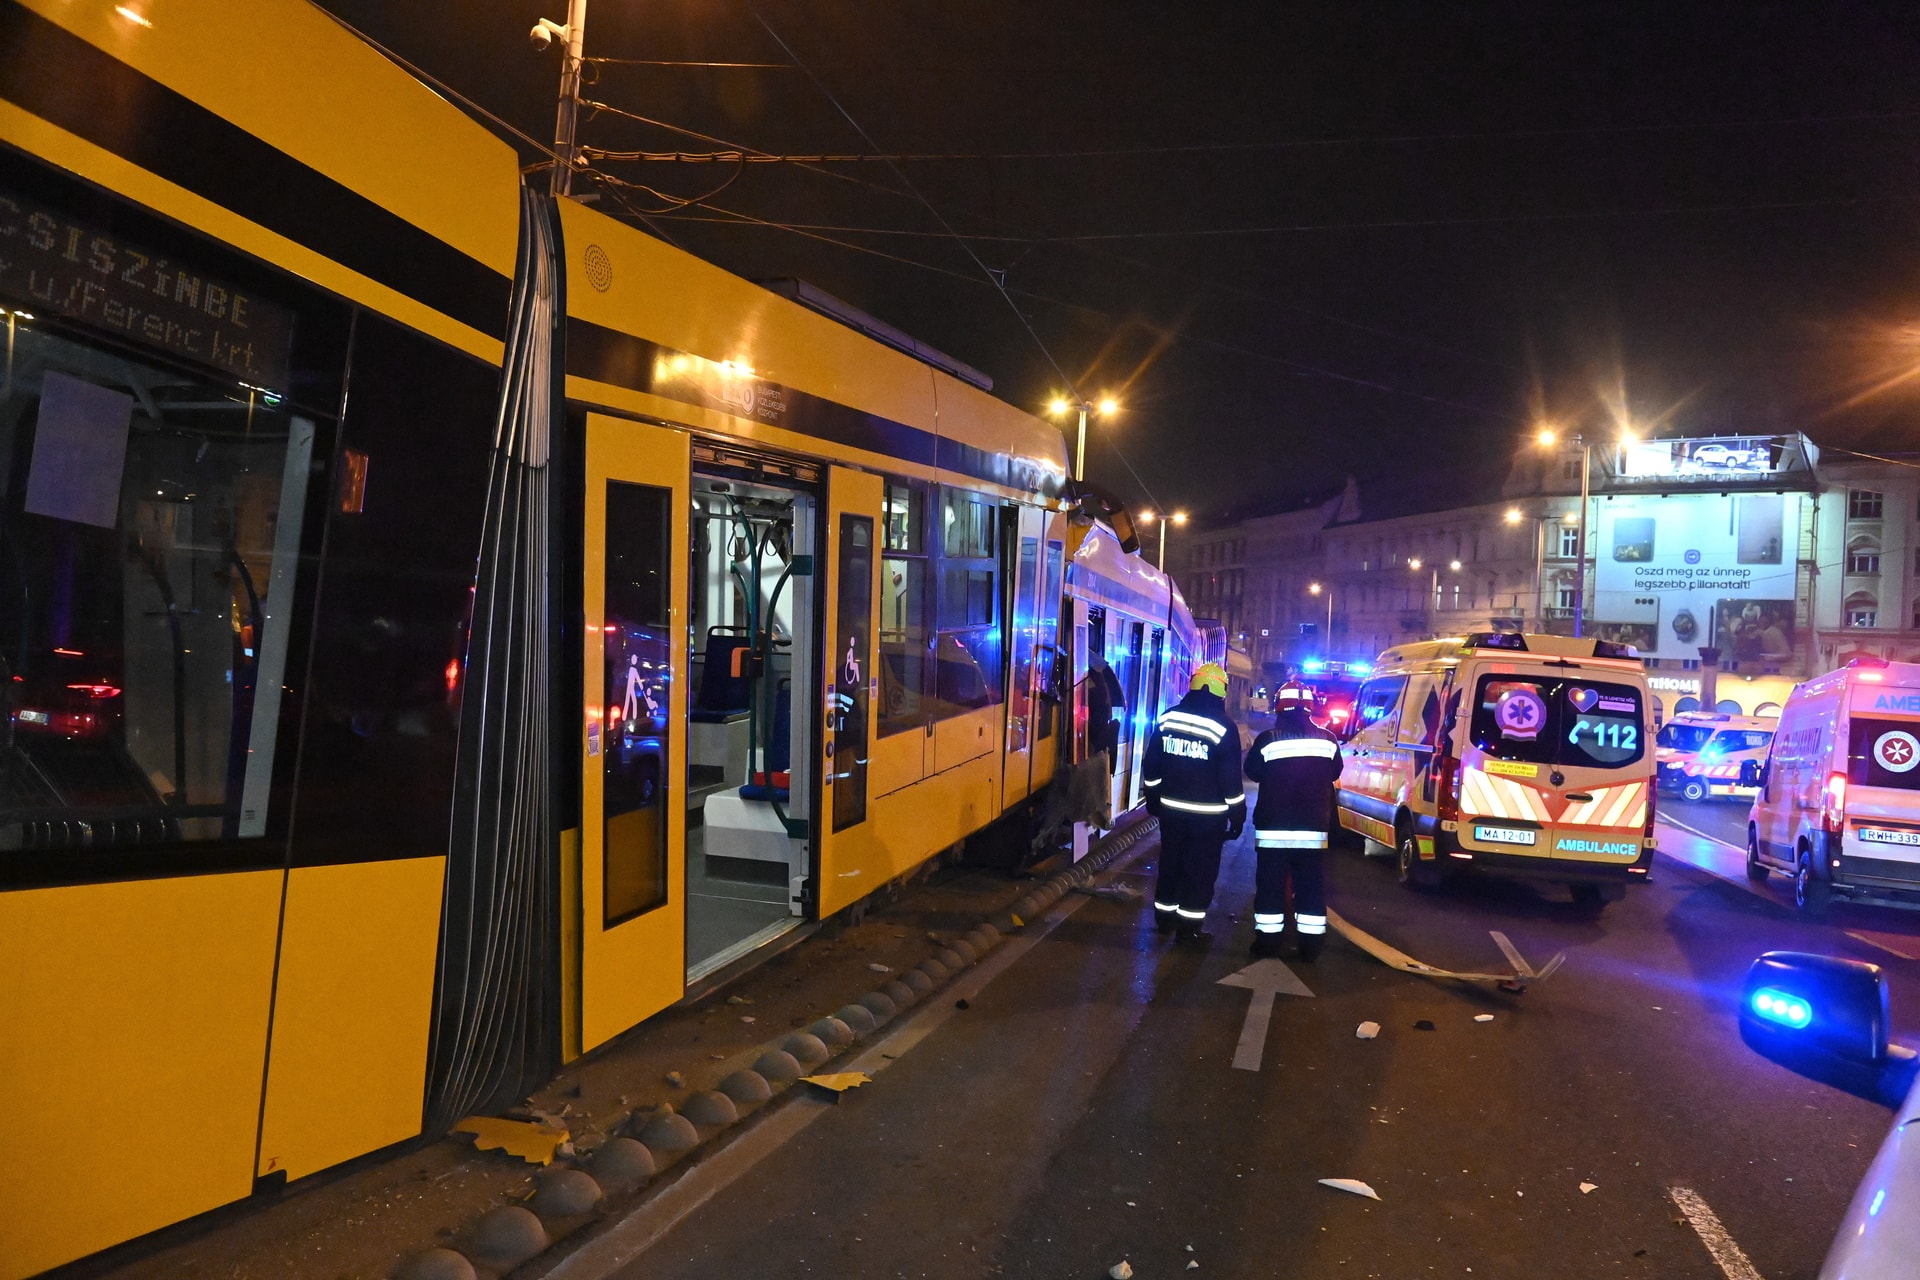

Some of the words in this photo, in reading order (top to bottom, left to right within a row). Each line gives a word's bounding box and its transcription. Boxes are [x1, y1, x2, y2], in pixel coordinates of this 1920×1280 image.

[1635, 567, 1664, 576] Oszd
[1666, 569, 1693, 578] meg
[1696, 568, 1710, 576] az
[1713, 567, 1751, 579] ünnep
[1634, 579, 1687, 591] legszebb
[1593, 722, 1637, 749] 112
[1483, 829, 1499, 839] MA
[1502, 831, 1532, 842] 12-01
[1868, 831, 1918, 844] RWH-339
[1556, 839, 1637, 856] AMBULANCE
